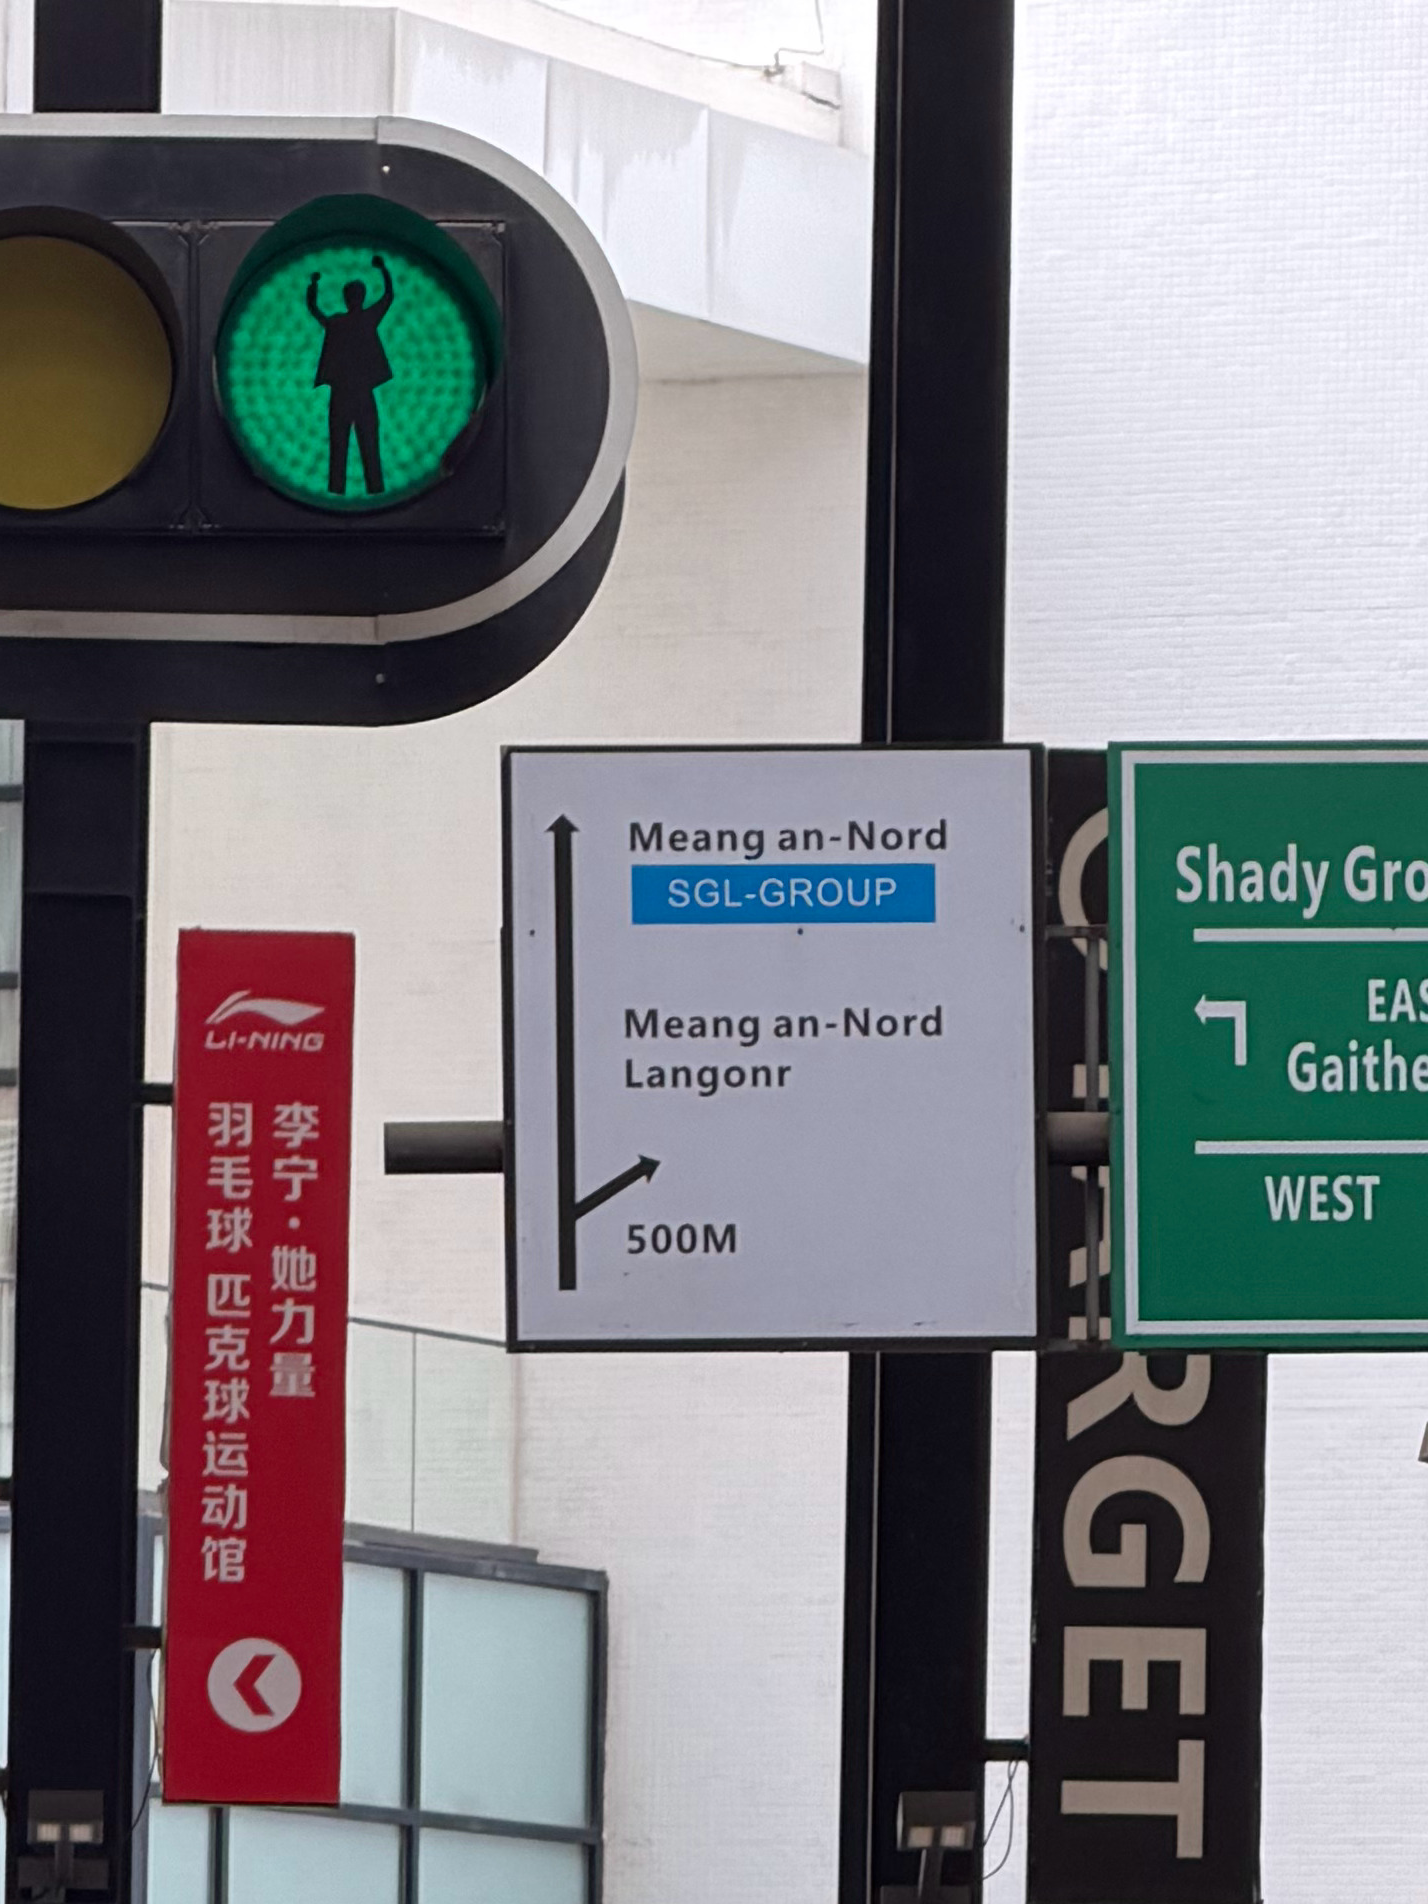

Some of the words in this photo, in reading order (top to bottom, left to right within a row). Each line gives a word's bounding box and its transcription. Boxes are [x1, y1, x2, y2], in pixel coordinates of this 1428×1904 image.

[628, 821, 766, 860] Meang
[777, 819, 948, 852] an-Nord
[667, 877, 898, 910] SGL-GROUP
[1174, 842, 1331, 920] Shady
[203, 1031, 326, 1052] LI-NING
[624, 1008, 761, 1047] Meang
[773, 1006, 943, 1039] an-Nord
[624, 1058, 792, 1097] Langonr
[1263, 1174, 1381, 1222] WEST
[626, 1223, 738, 1255] 500M
